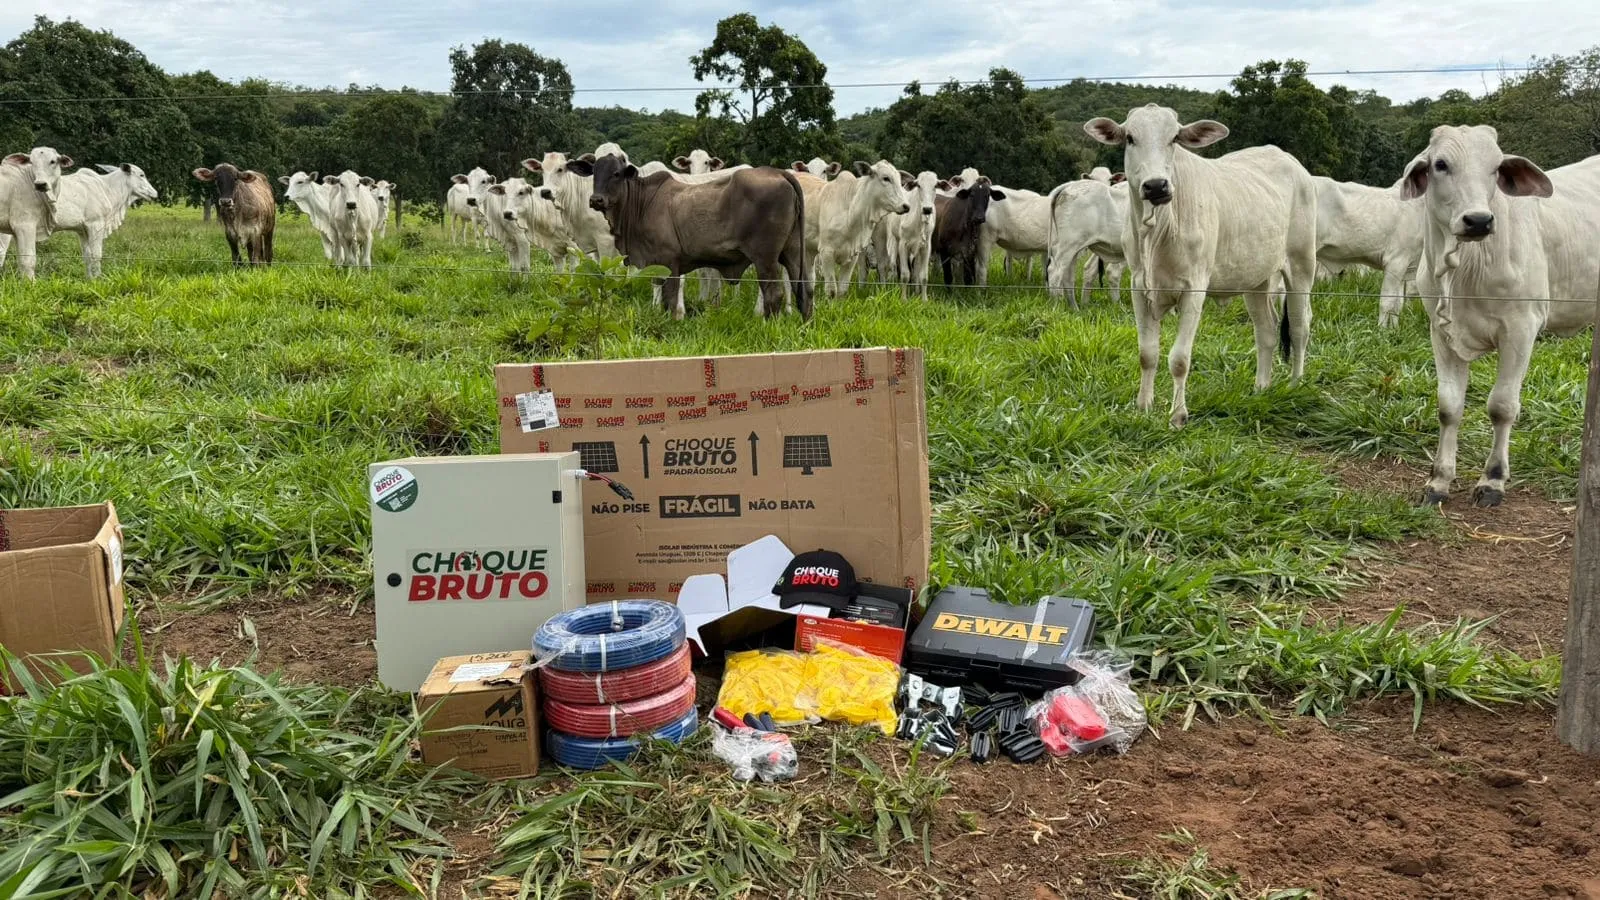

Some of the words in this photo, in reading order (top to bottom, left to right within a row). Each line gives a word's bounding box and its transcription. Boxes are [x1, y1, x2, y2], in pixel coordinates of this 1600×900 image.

[664, 437, 736, 452] CHOQUE
[663, 450, 737, 466] BRUTO
[664, 467, 737, 475] #PADRÃOISOLAR
[375, 473, 402, 492] BRUTO
[591, 502, 619, 514] NÃO
[622, 503, 650, 513] PISE
[665, 495, 736, 513] FRÁGIL
[748, 498, 777, 510] NÃO
[780, 500, 815, 510] BATA
[411, 549, 548, 575] CHOQUE
[794, 566, 840, 577] CHOQUE
[408, 571, 548, 602] BRUTO
[792, 575, 839, 587] BRUTO
